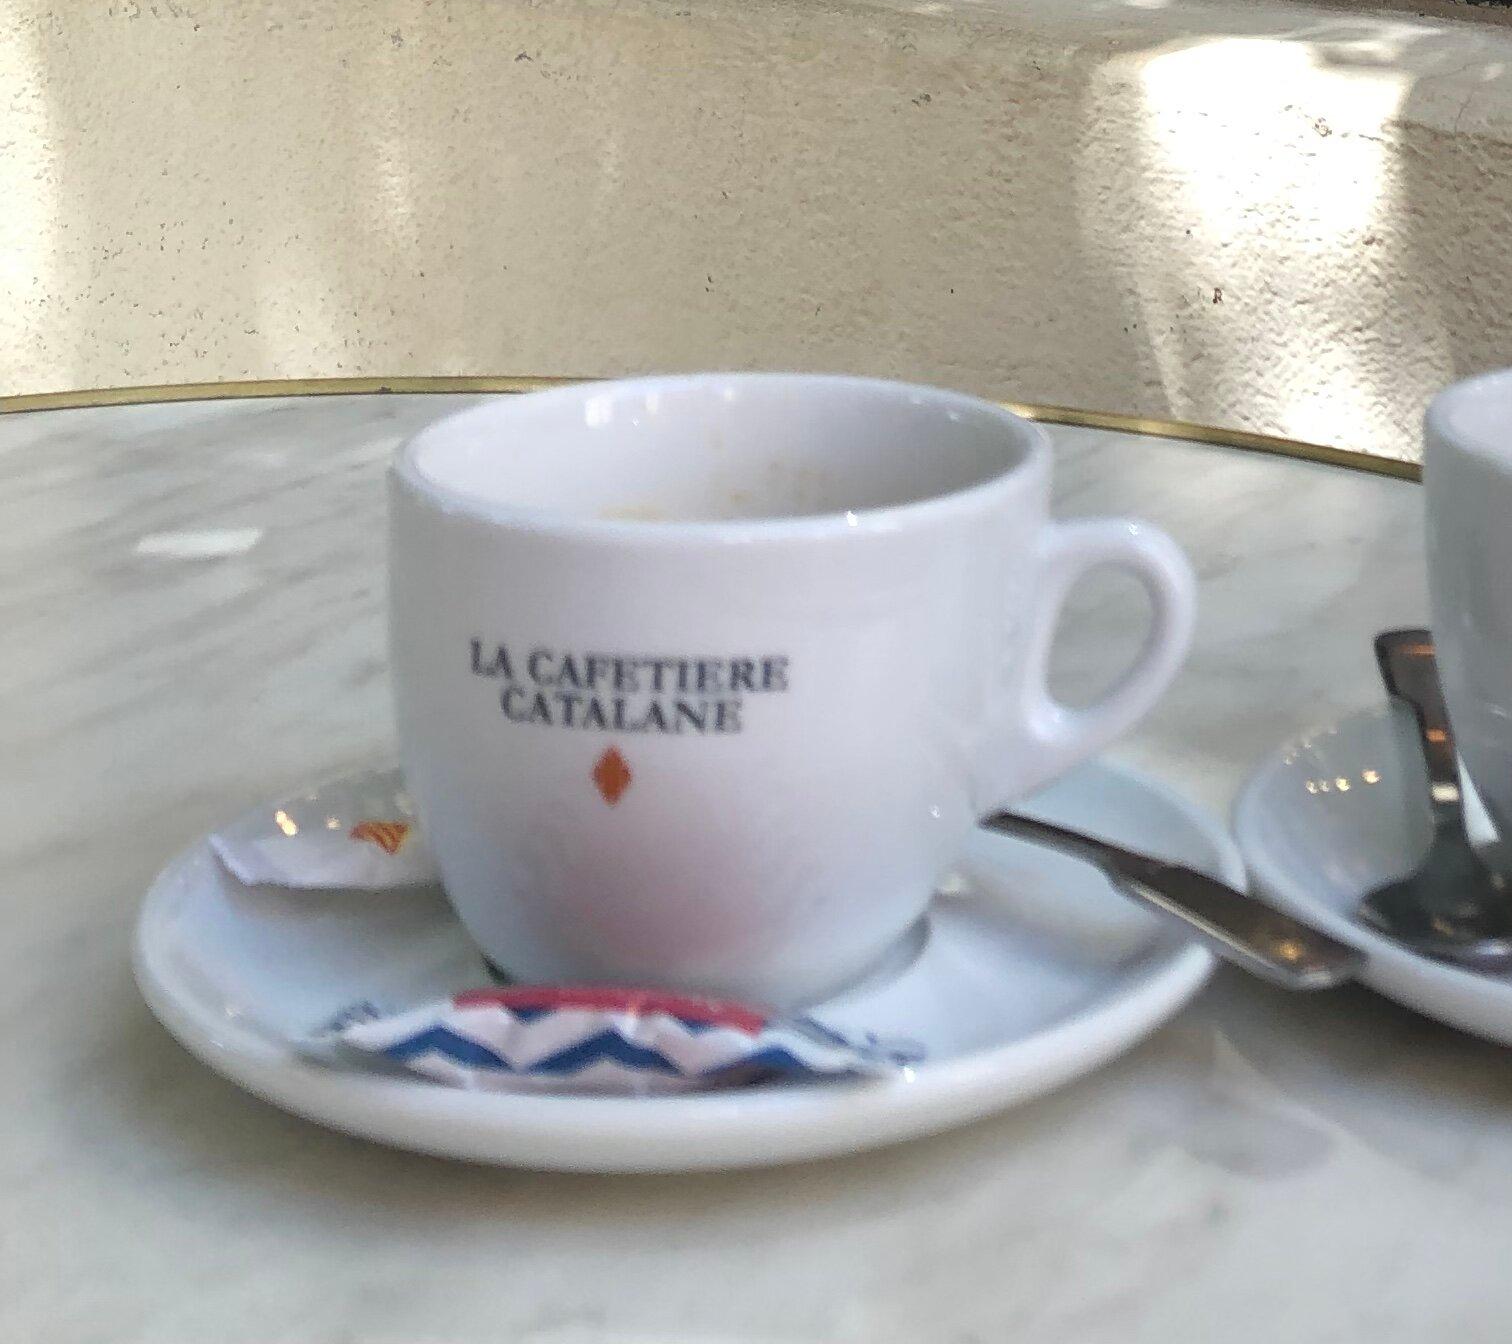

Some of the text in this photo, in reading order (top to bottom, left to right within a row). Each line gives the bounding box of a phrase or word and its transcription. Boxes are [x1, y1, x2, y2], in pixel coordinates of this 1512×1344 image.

[469, 637, 790, 693] LA CAFETIERE
[500, 685, 743, 734] CATALANE
